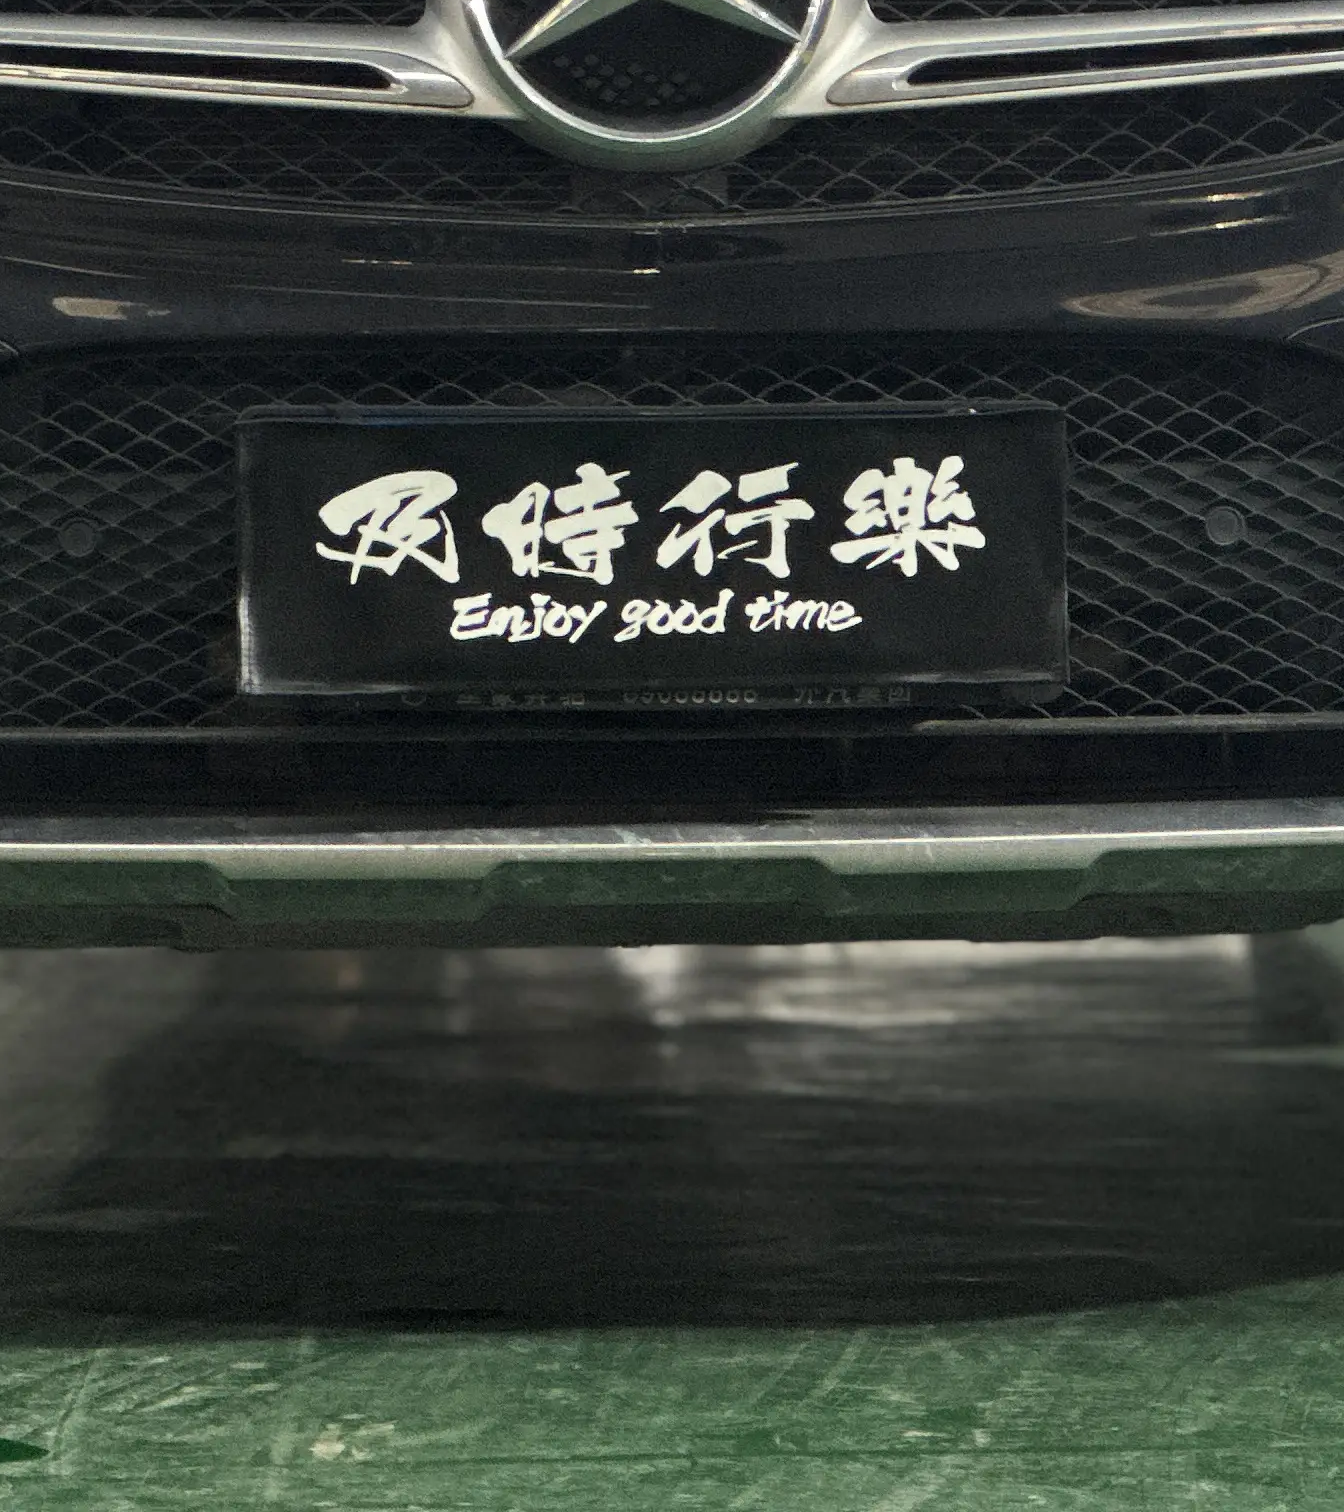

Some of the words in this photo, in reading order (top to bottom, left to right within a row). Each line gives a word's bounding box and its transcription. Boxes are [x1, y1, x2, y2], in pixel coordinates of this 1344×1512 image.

[316, 456, 986, 585] 及時行樂
[450, 592, 608, 644] Enjoy
[614, 588, 735, 642] good
[745, 590, 863, 632] time
